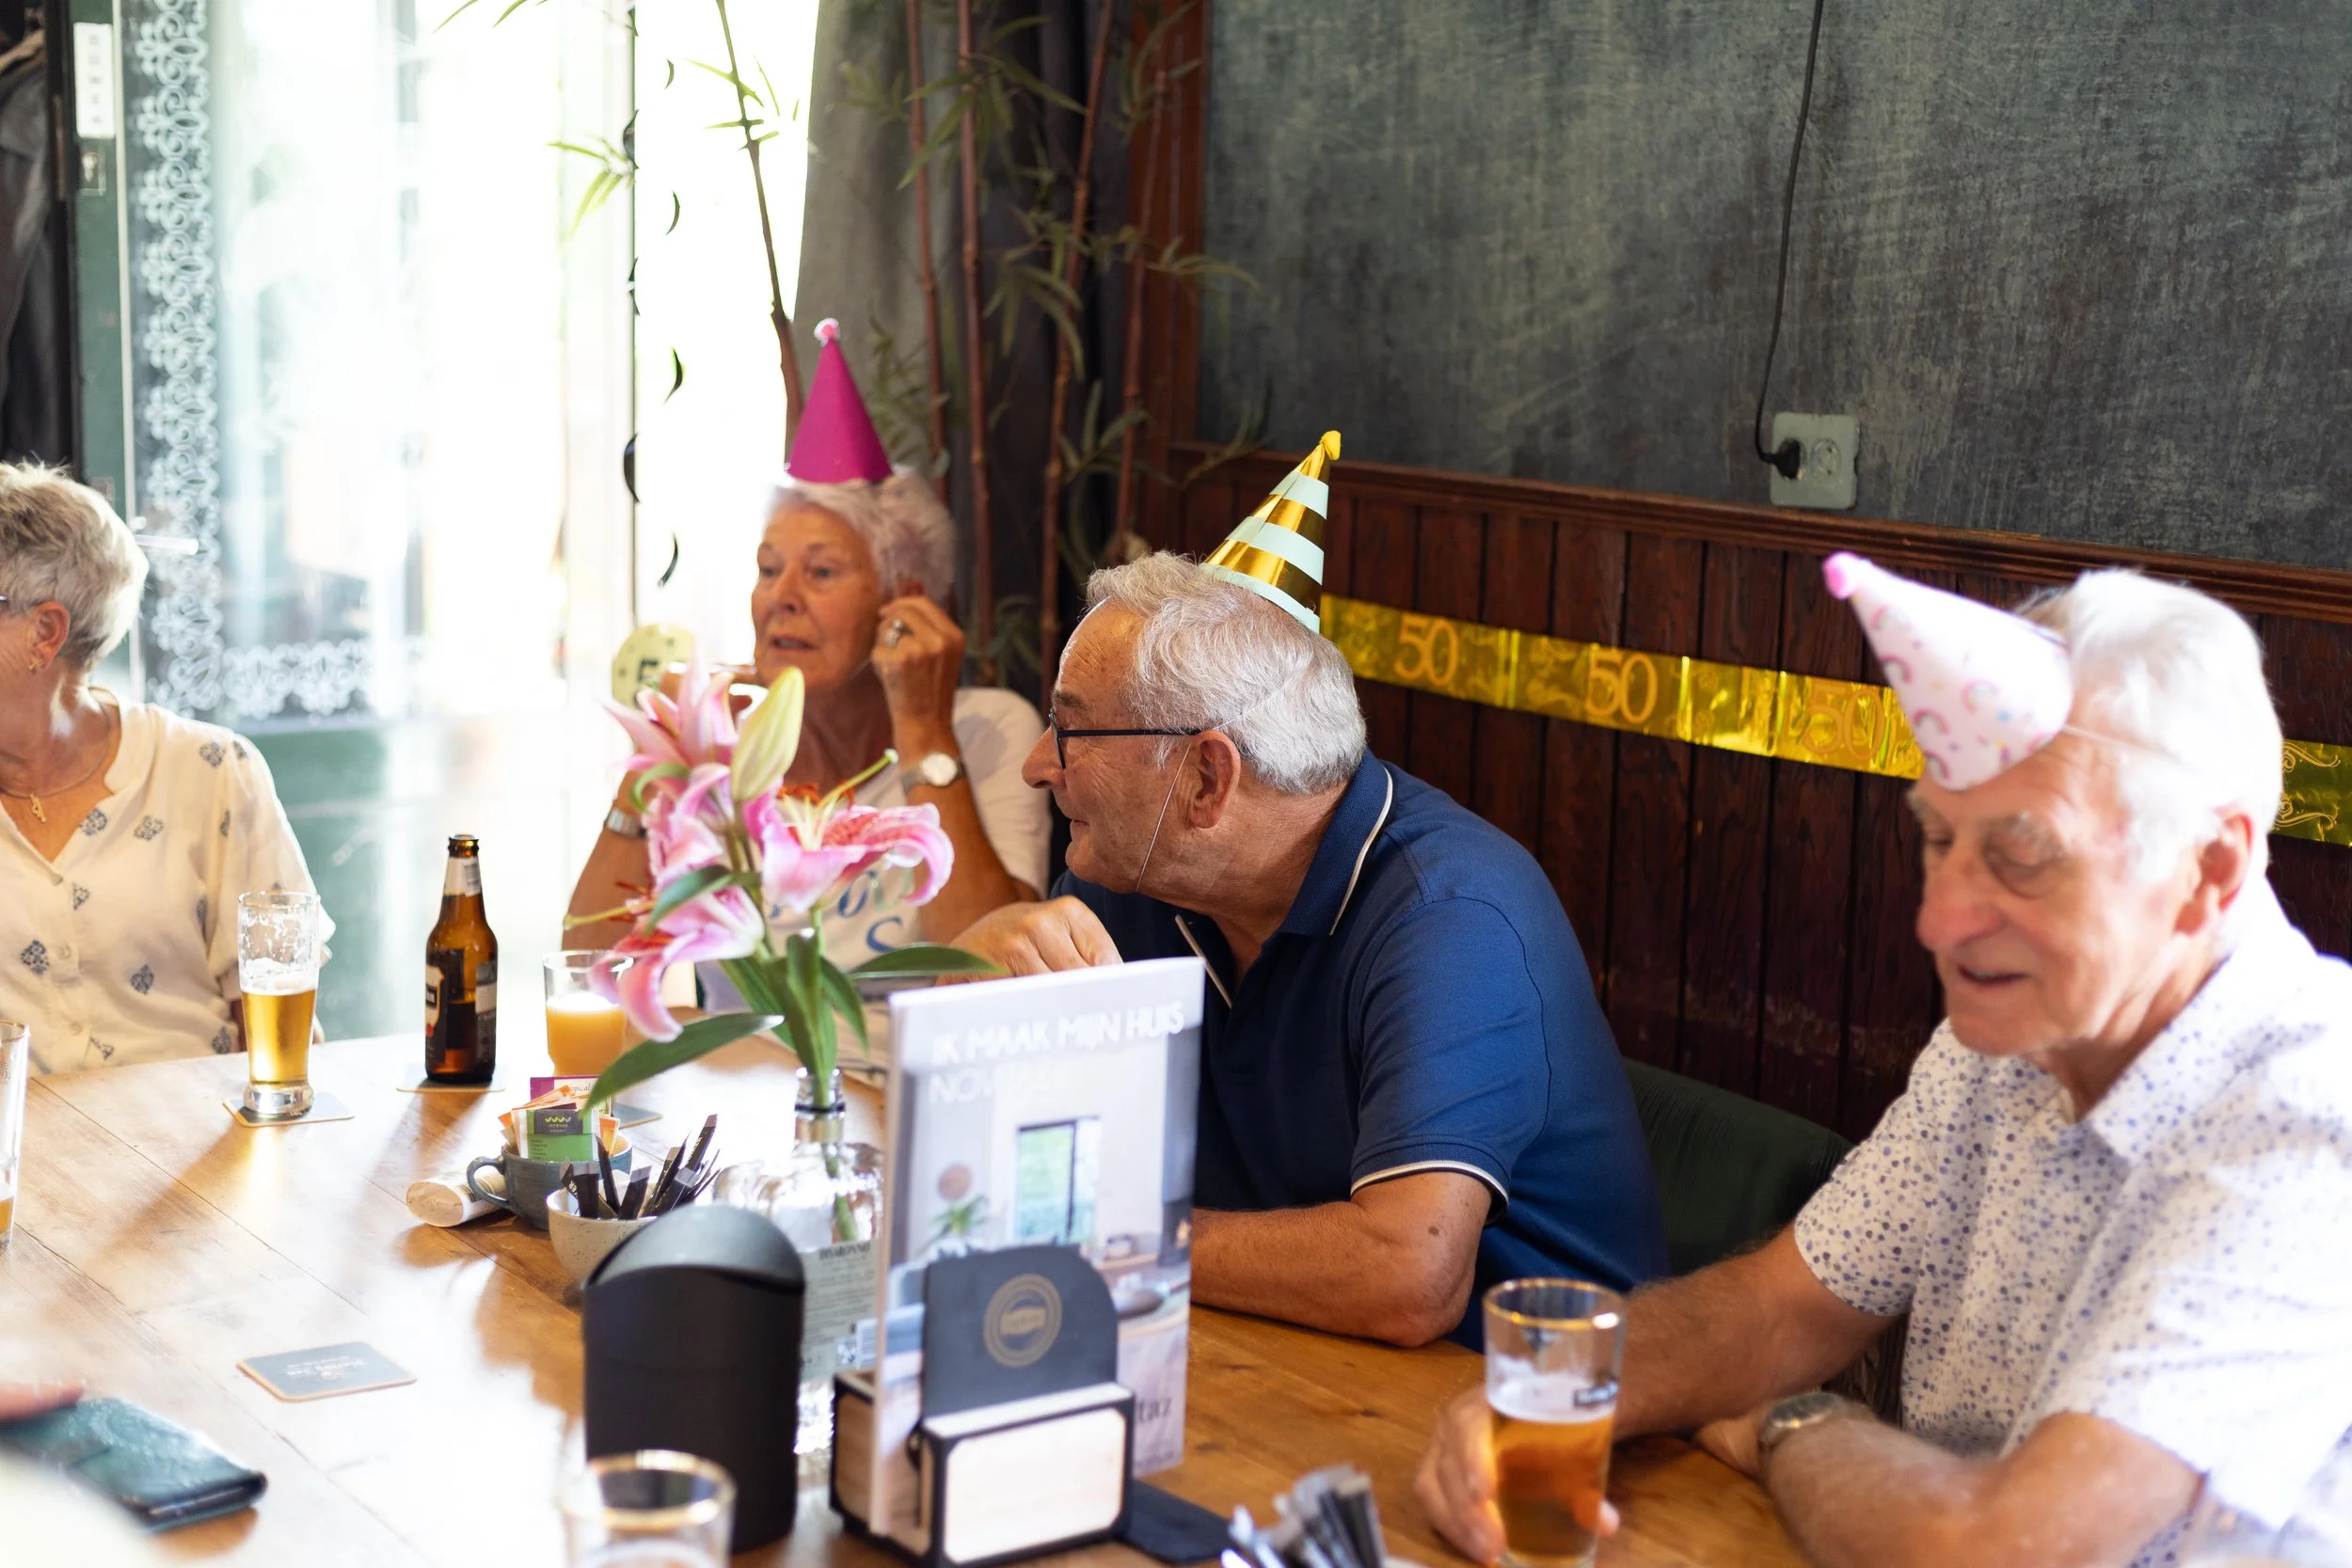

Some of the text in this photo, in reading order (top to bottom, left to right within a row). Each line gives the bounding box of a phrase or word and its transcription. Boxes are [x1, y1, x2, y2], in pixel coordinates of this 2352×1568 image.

[1392, 612, 1885, 761] 50 50 50
[930, 1031, 961, 1067] IK
[965, 1019, 1053, 1062] MAAK
[1126, 1000, 1185, 1041] HUIS
